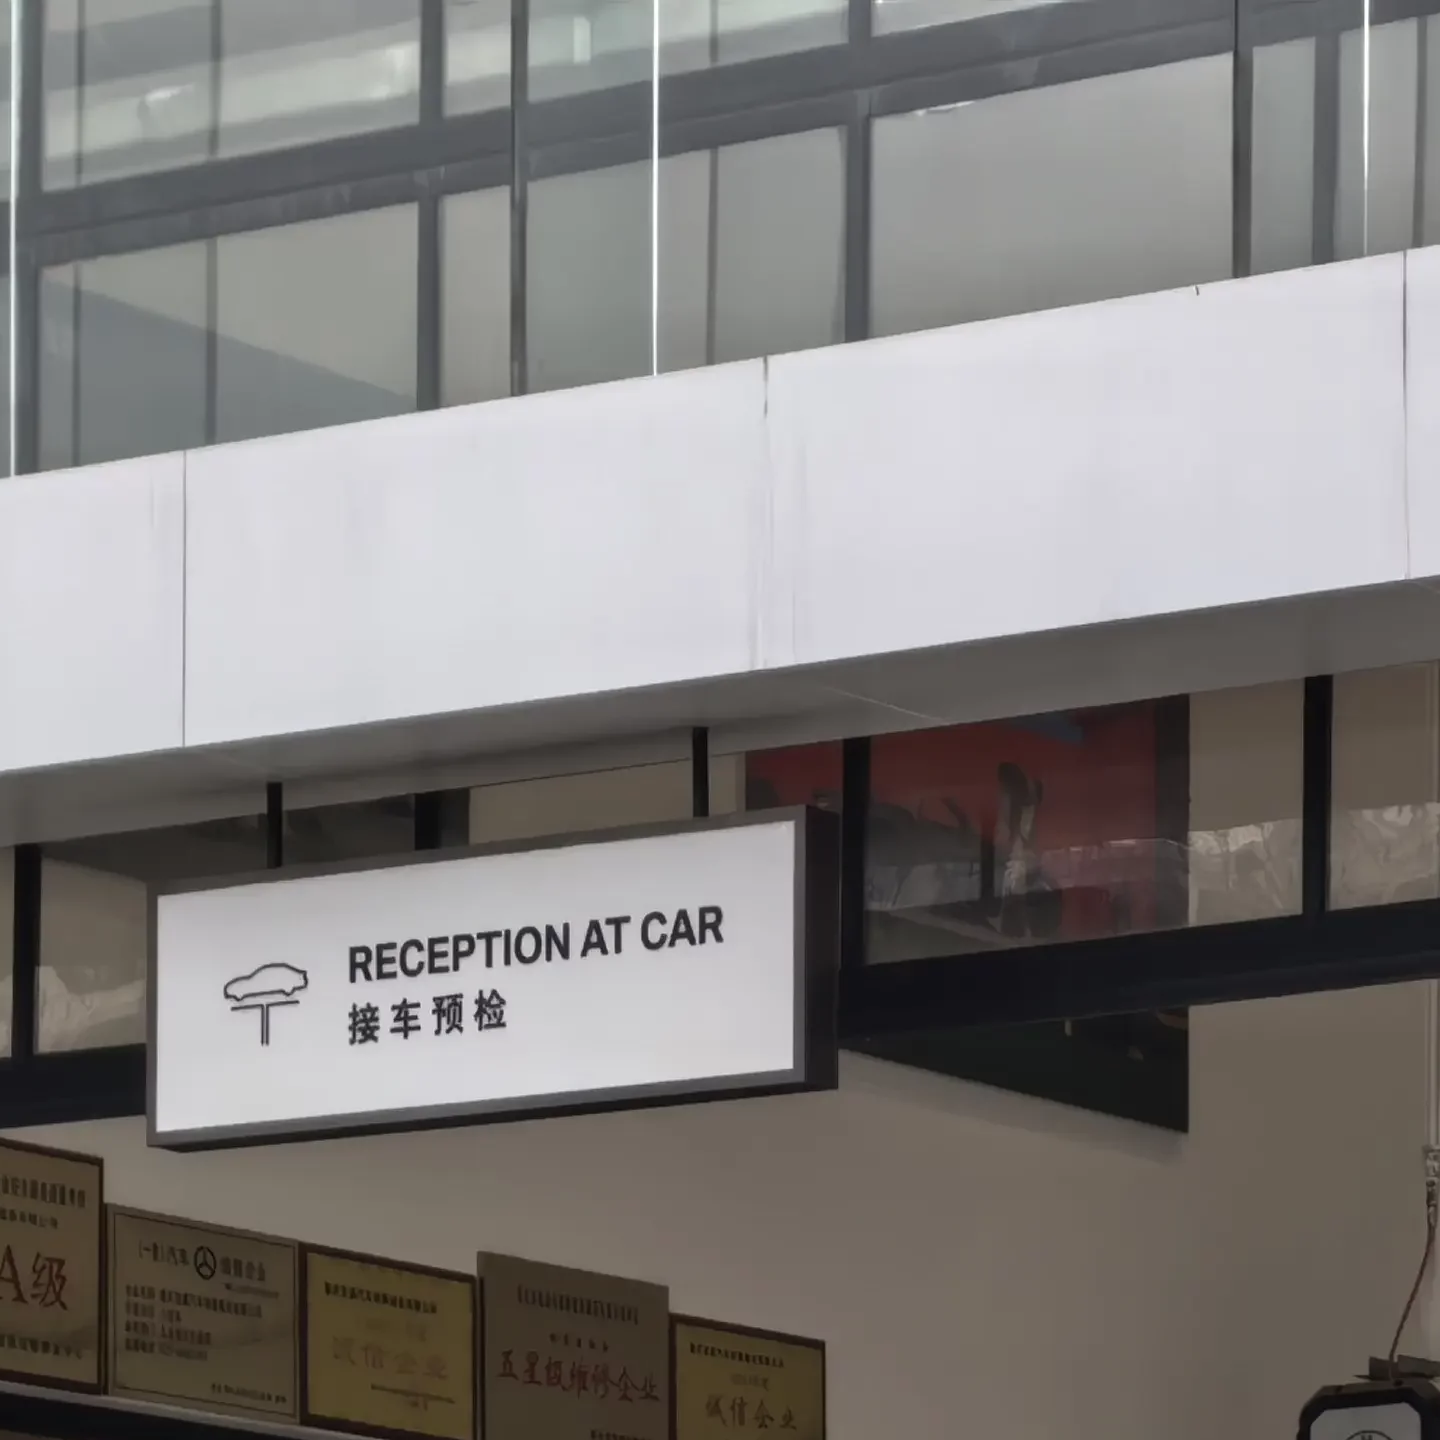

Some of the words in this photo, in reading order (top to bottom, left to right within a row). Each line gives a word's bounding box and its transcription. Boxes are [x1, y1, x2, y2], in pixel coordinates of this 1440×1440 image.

[348, 922, 572, 984] RECEPTION
[579, 915, 631, 958] AT
[639, 905, 725, 952] CAR
[347, 989, 508, 1046] 接车预检
